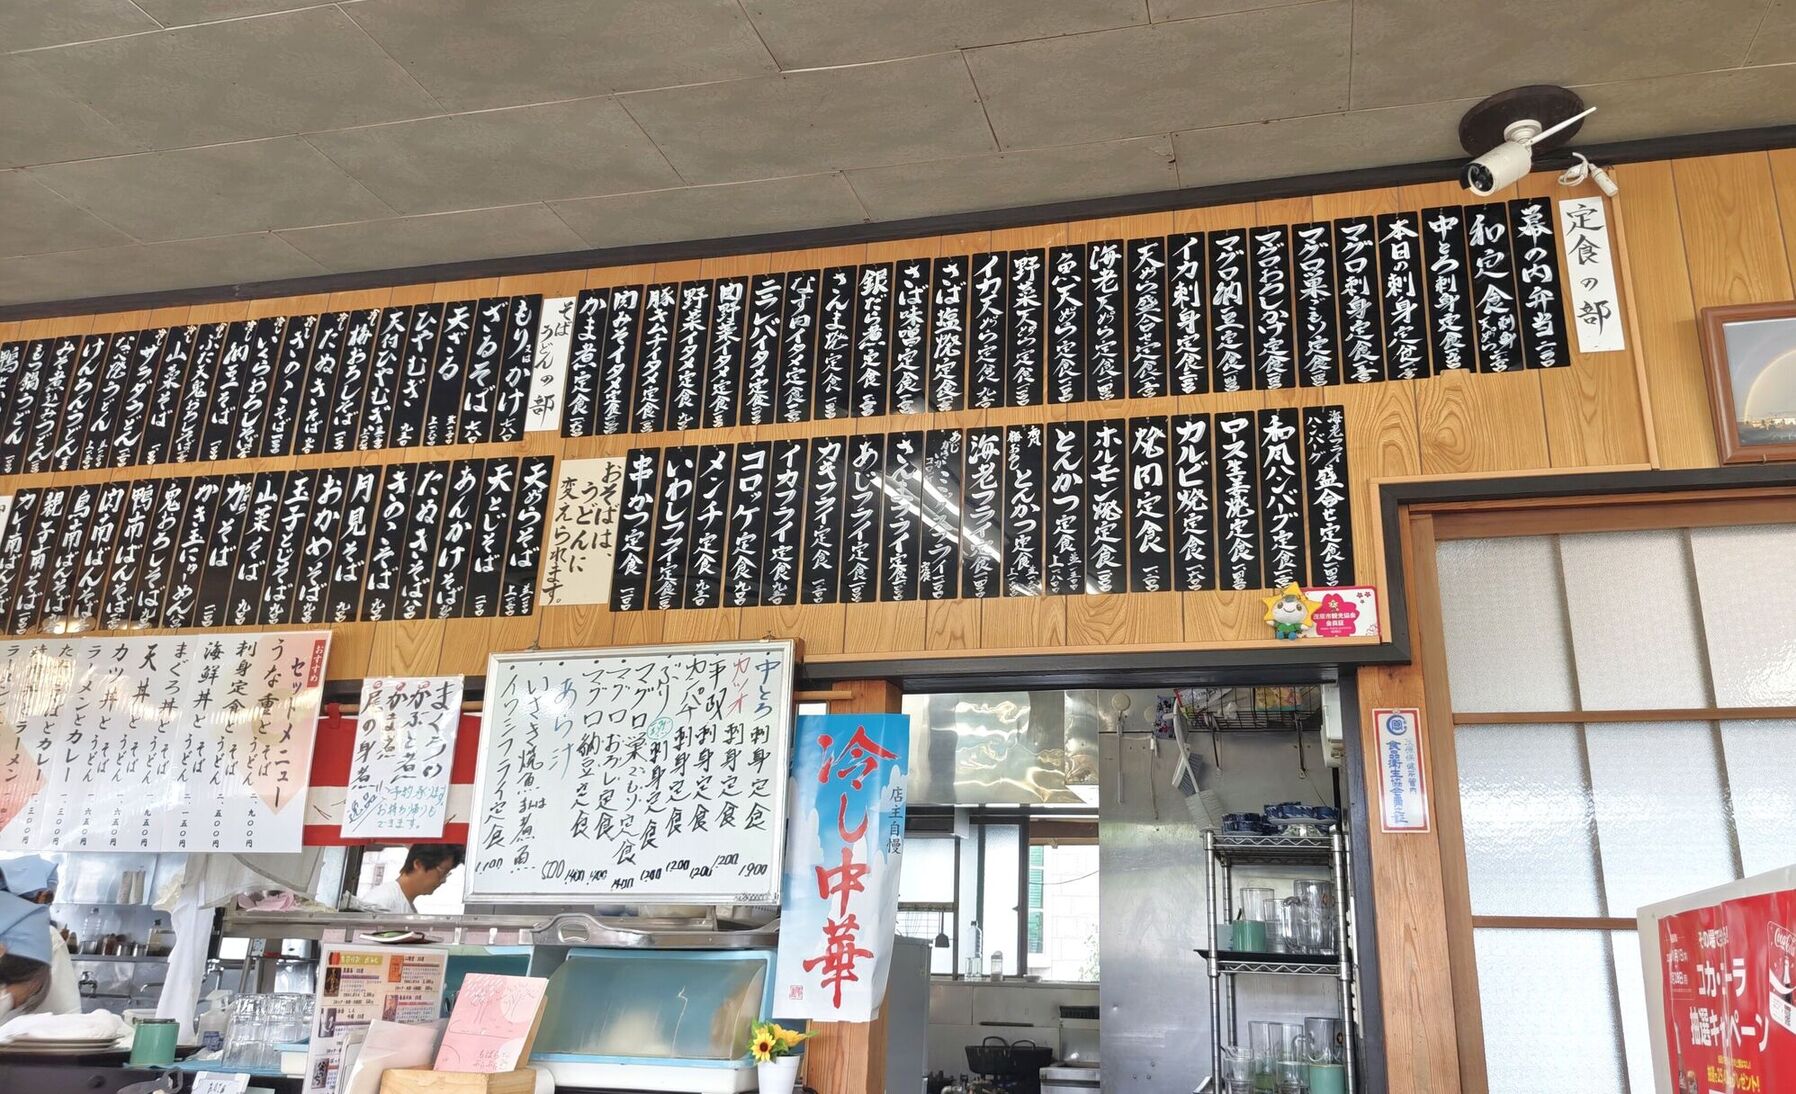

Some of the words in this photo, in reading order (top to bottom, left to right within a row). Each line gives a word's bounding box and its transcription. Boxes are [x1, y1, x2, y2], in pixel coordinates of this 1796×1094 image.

[554, 301, 575, 337] そば
[1172, 237, 1203, 371] イカ刺身定食
[1213, 236, 1245, 372] マグロ納豆定食
[1341, 224, 1379, 363] マグロ刺身定食
[1381, 219, 1421, 366] 本日の刺身定食
[1428, 215, 1465, 351] 中とろ刺身定食
[1518, 205, 1554, 337] 幕の内弁当
[1566, 204, 1611, 336] 定食の部
[212, 342, 249, 425] 納豆そば
[675, 287, 708, 408] 野菜イタメ定食
[709, 283, 743, 413] 肉野菜イタメ定食
[238, 480, 277, 581] 山菜そば
[265, 477, 309, 601] 玉子とじそば
[299, 475, 342, 601] おかめそば
[335, 474, 374, 581] 月見そば
[475, 464, 512, 572] 天とじそば
[542, 477, 577, 605] 変えられます。
[569, 482, 598, 573] うどんに
[592, 461, 622, 557] おそばは、
[619, 455, 653, 575] 串かつ定食
[655, 459, 693, 598] いわしフライ定食
[693, 451, 725, 574] メンチ定食
[732, 450, 765, 580] コロッケ定食
[770, 445, 800, 581] イカフライ定食
[811, 442, 841, 569] カキフライ定食
[848, 442, 881, 580] あじフライ定食
[1010, 469, 1040, 571] とんかつ定食
[1052, 429, 1083, 555] とんかつ定食
[1091, 427, 1122, 568] ホルモン焼定食
[1132, 426, 1166, 553] 焼肉定食
[1176, 421, 1208, 560] カルビ焼定食
[1221, 418, 1255, 562] ロース生姜焼定食
[1262, 415, 1298, 571] 和風ハンバーグ定食
[65, 645, 102, 782] ラーメンとカレー
[100, 643, 129, 730] カツ丼と
[129, 643, 159, 729] 天丼と
[157, 641, 189, 734] まぐろ丼と
[193, 641, 224, 729] 海鮮丼と
[223, 641, 257, 734] 刺身定食と
[258, 639, 284, 735] うな重と
[310, 646, 324, 682] おすすめ
[82, 735, 98, 783] うどん
[97, 742, 109, 773] そば
[111, 734, 127, 782] うどん
[126, 742, 138, 772] そば
[142, 735, 157, 785] うどん
[157, 743, 169, 775] そば
[177, 733, 192, 782] うどん
[192, 741, 205, 773] そば
[210, 736, 225, 785] うどん
[225, 744, 238, 776] そば
[243, 736, 257, 786] うどん
[258, 745, 270, 777] そば
[275, 657, 305, 807] セットメニュー
[571, 669, 605, 839] マグロ納豆定食
[744, 658, 781, 831] 中とろ刺身定食
[802, 724, 900, 1009] 冷し中華
[886, 786, 904, 855] 店主自慢
